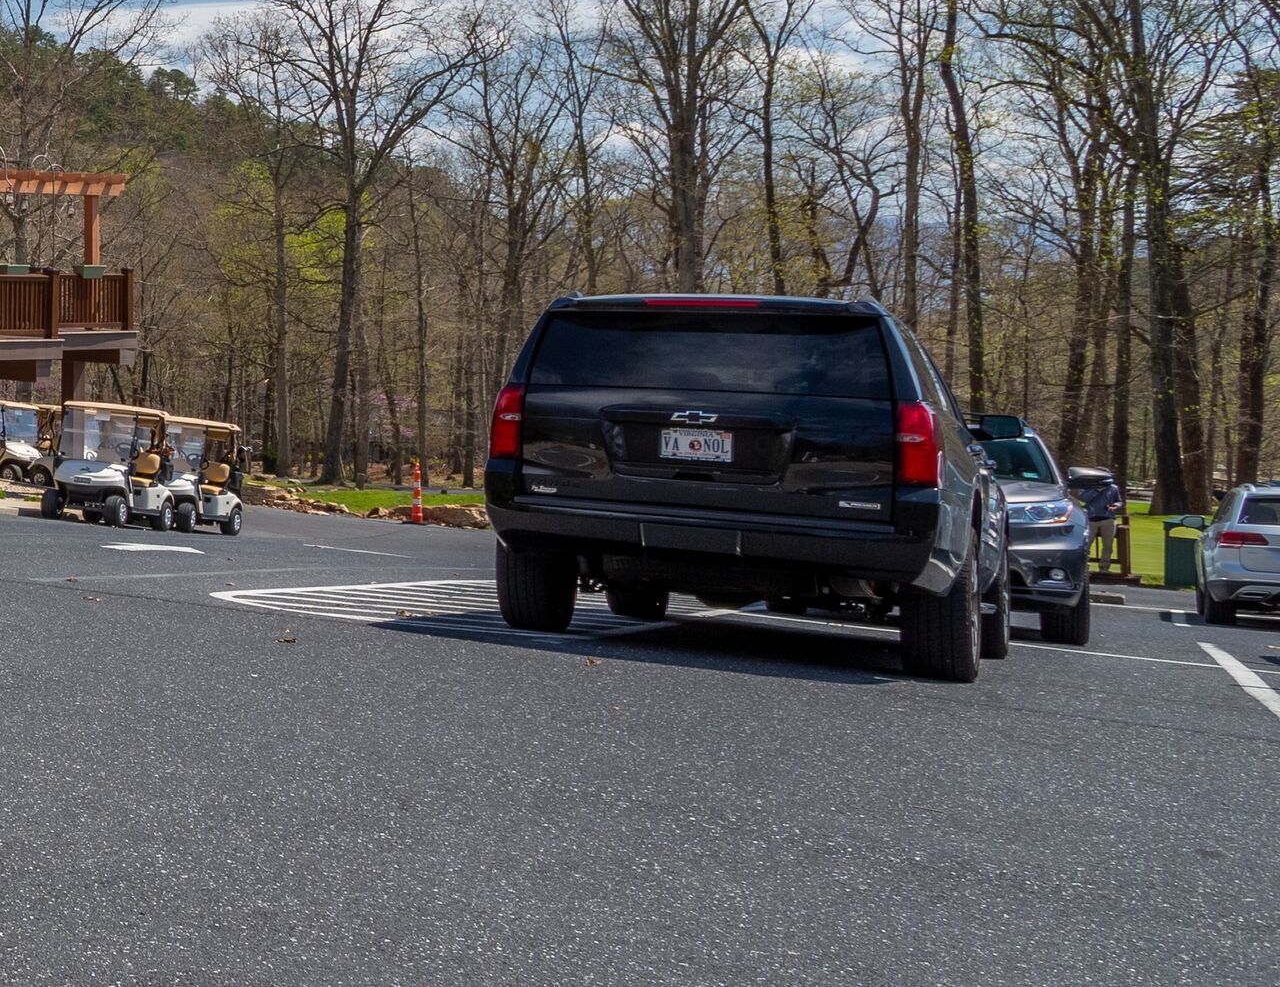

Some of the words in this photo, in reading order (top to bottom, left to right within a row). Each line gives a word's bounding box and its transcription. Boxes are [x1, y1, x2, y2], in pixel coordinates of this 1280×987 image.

[679, 430, 714, 438] VIRGINIA
[663, 436, 680, 451] VA
[703, 438, 729, 454] NOL
